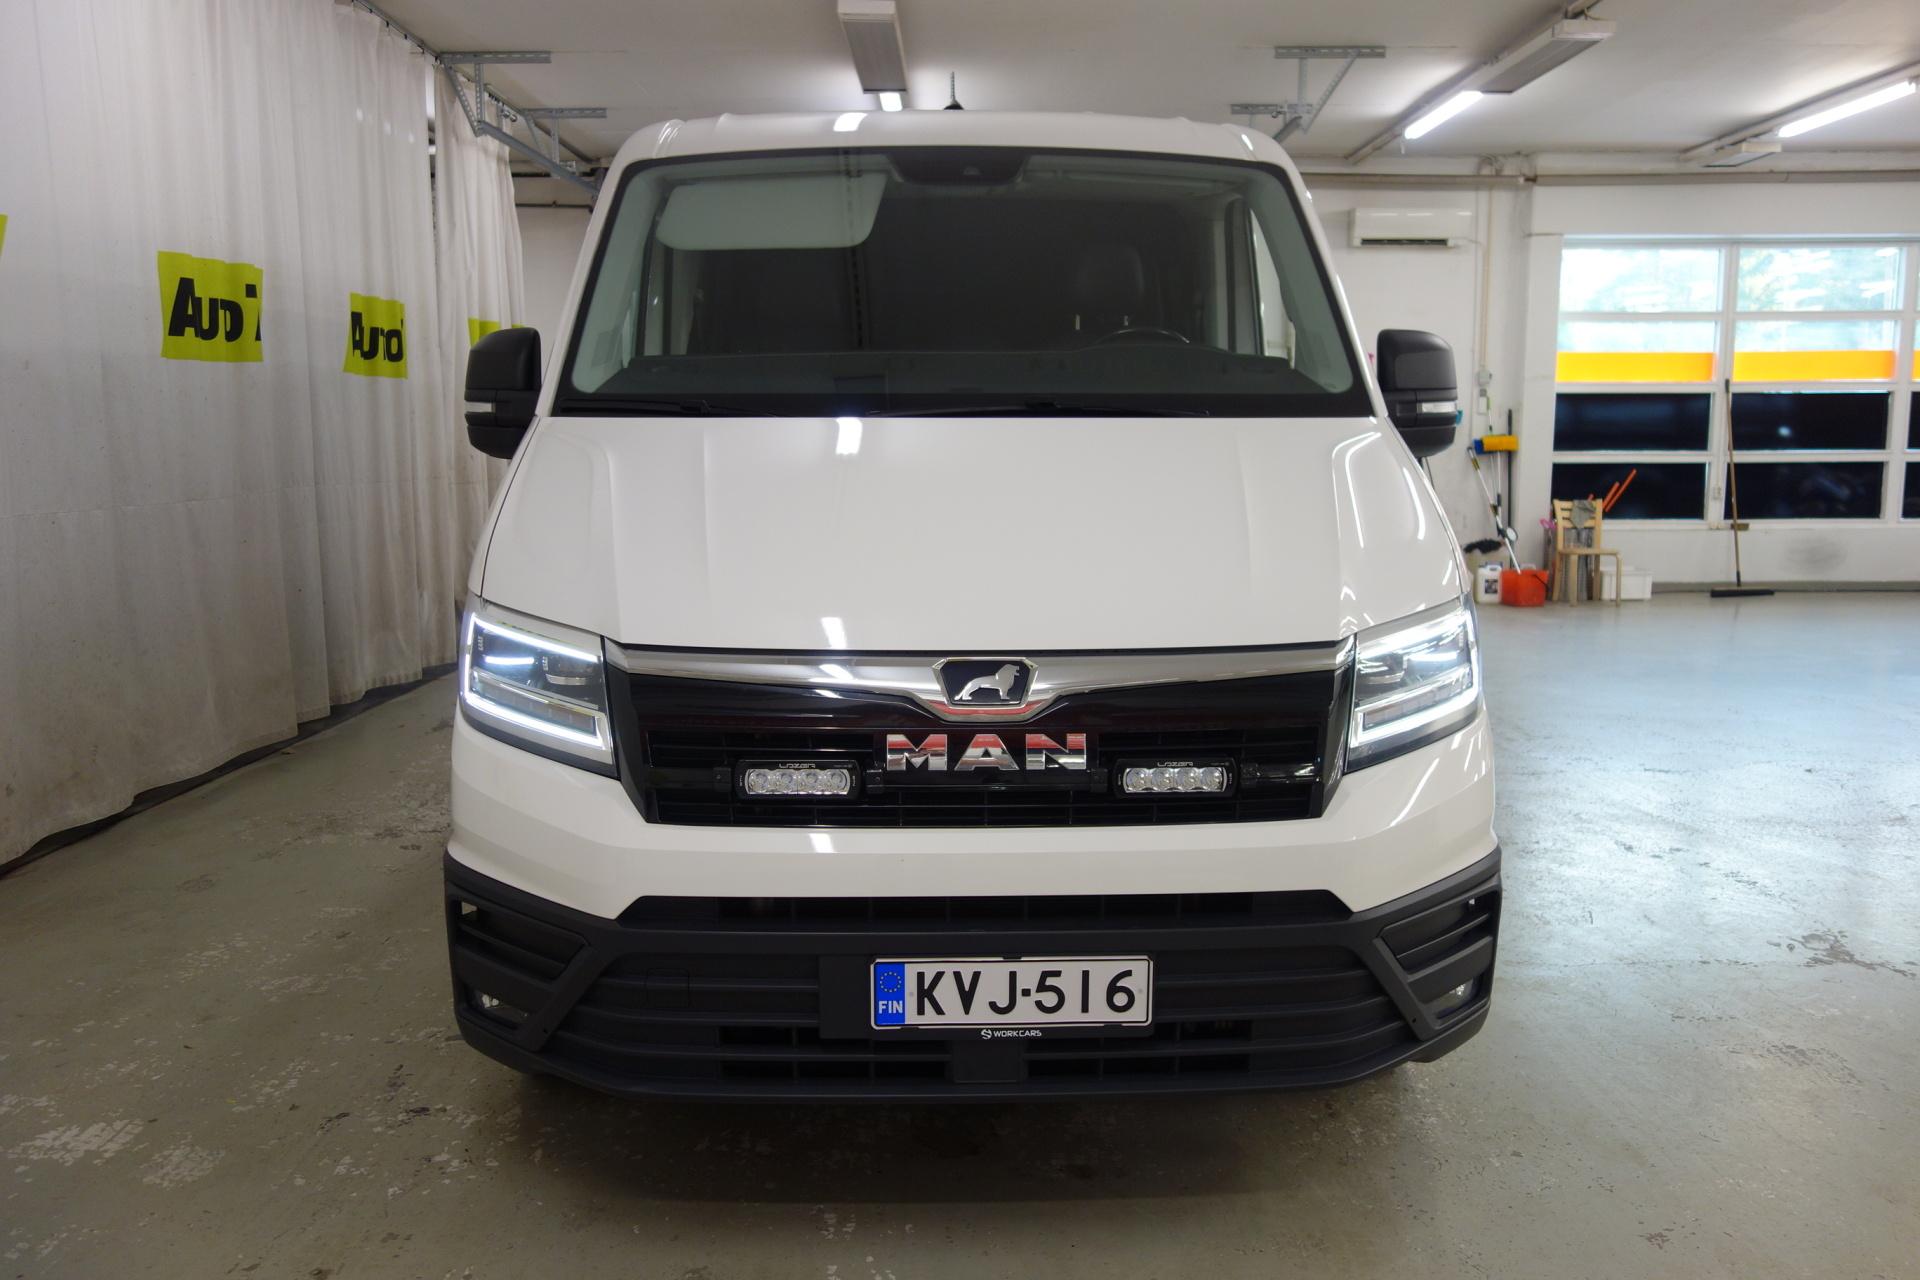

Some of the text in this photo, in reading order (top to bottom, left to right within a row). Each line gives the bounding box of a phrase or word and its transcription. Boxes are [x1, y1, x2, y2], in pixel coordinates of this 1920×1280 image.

[886, 733, 1087, 771] MAN
[878, 1000, 903, 1014] FIN
[916, 969, 1136, 1016] KVJ-516
